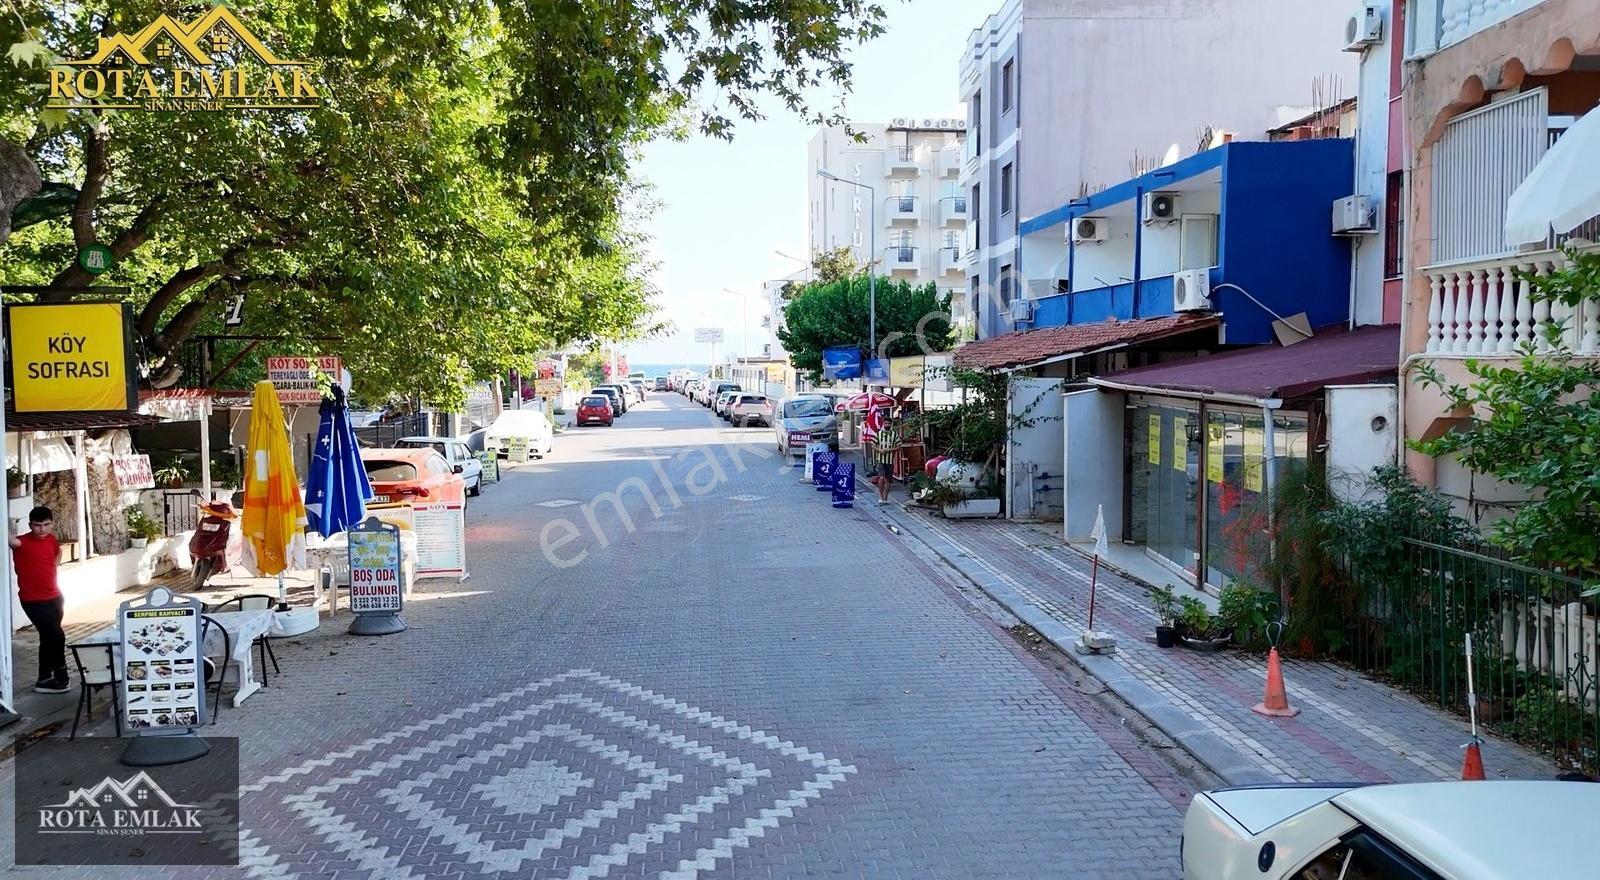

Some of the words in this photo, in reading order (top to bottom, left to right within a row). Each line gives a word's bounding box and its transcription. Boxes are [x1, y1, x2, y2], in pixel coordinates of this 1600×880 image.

[48, 332, 86, 354] KÖY
[28, 361, 110, 379] SOFRASI
[270, 358, 290, 369] KÖY
[292, 358, 335, 369] SOASI
[353, 569, 373, 585] BOŞ
[375, 569, 396, 581] ODA
[353, 585, 398, 596] BULUNUR
